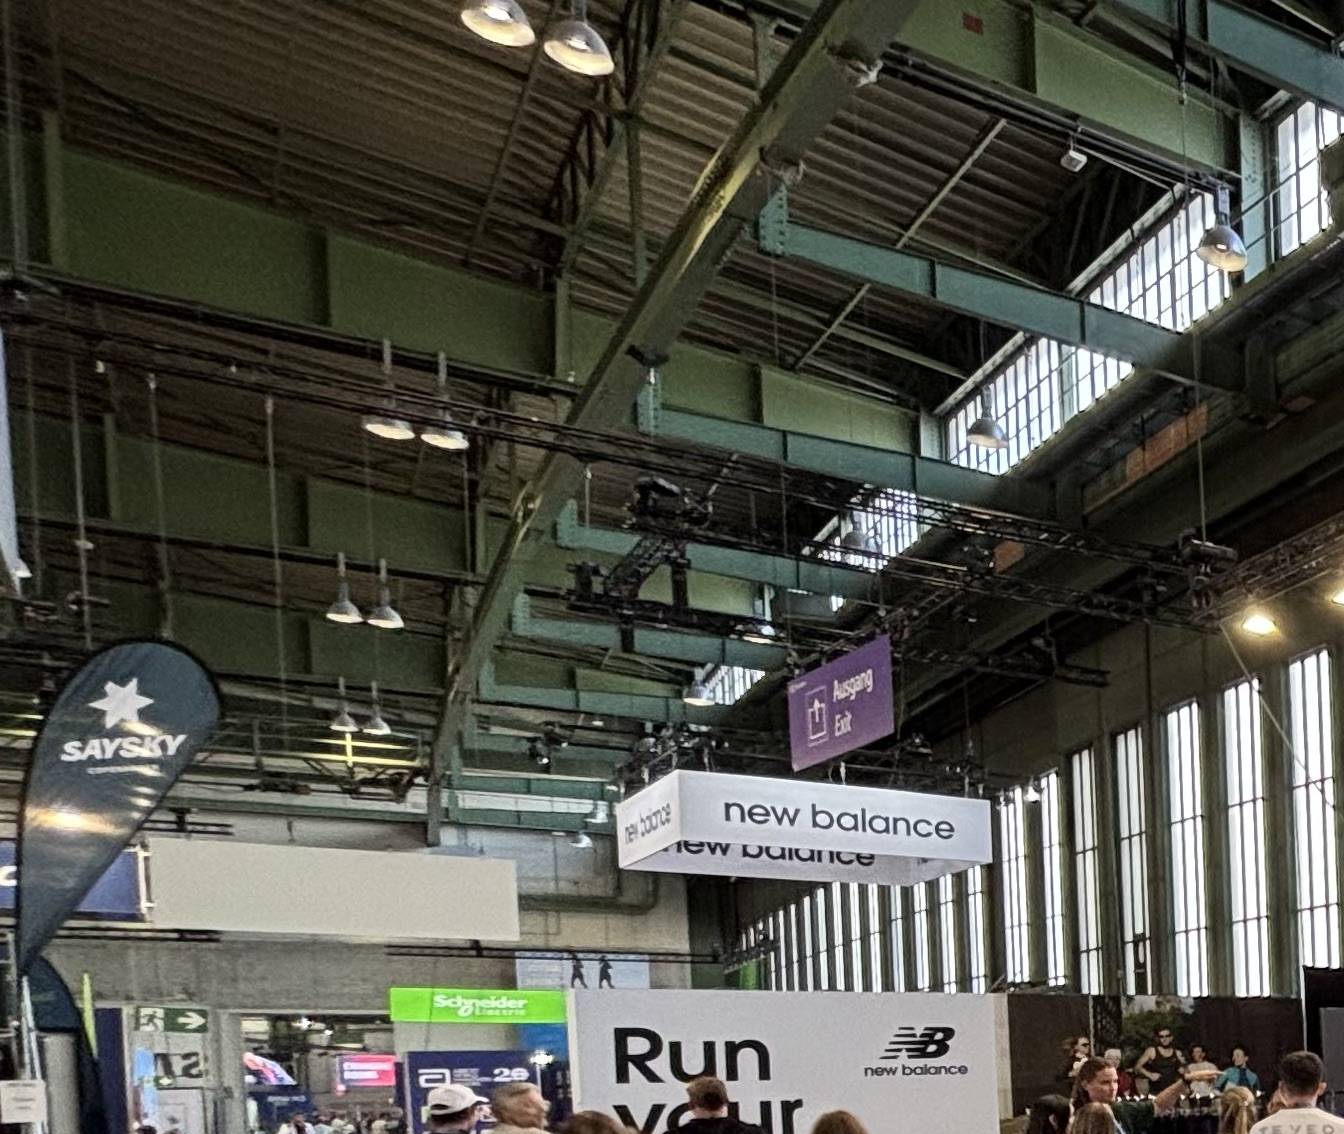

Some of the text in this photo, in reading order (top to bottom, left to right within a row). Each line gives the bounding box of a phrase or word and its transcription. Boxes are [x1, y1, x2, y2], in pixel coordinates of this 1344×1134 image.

[833, 668, 873, 702] Ausgang
[834, 710, 852, 737] Exit
[60, 734, 188, 762] SAYSKY
[624, 802, 672, 844] new balance
[724, 801, 956, 840] new balance
[433, 994, 528, 1017] Schneider
[613, 1027, 771, 1084] Run
[864, 1063, 968, 1077] new balance
